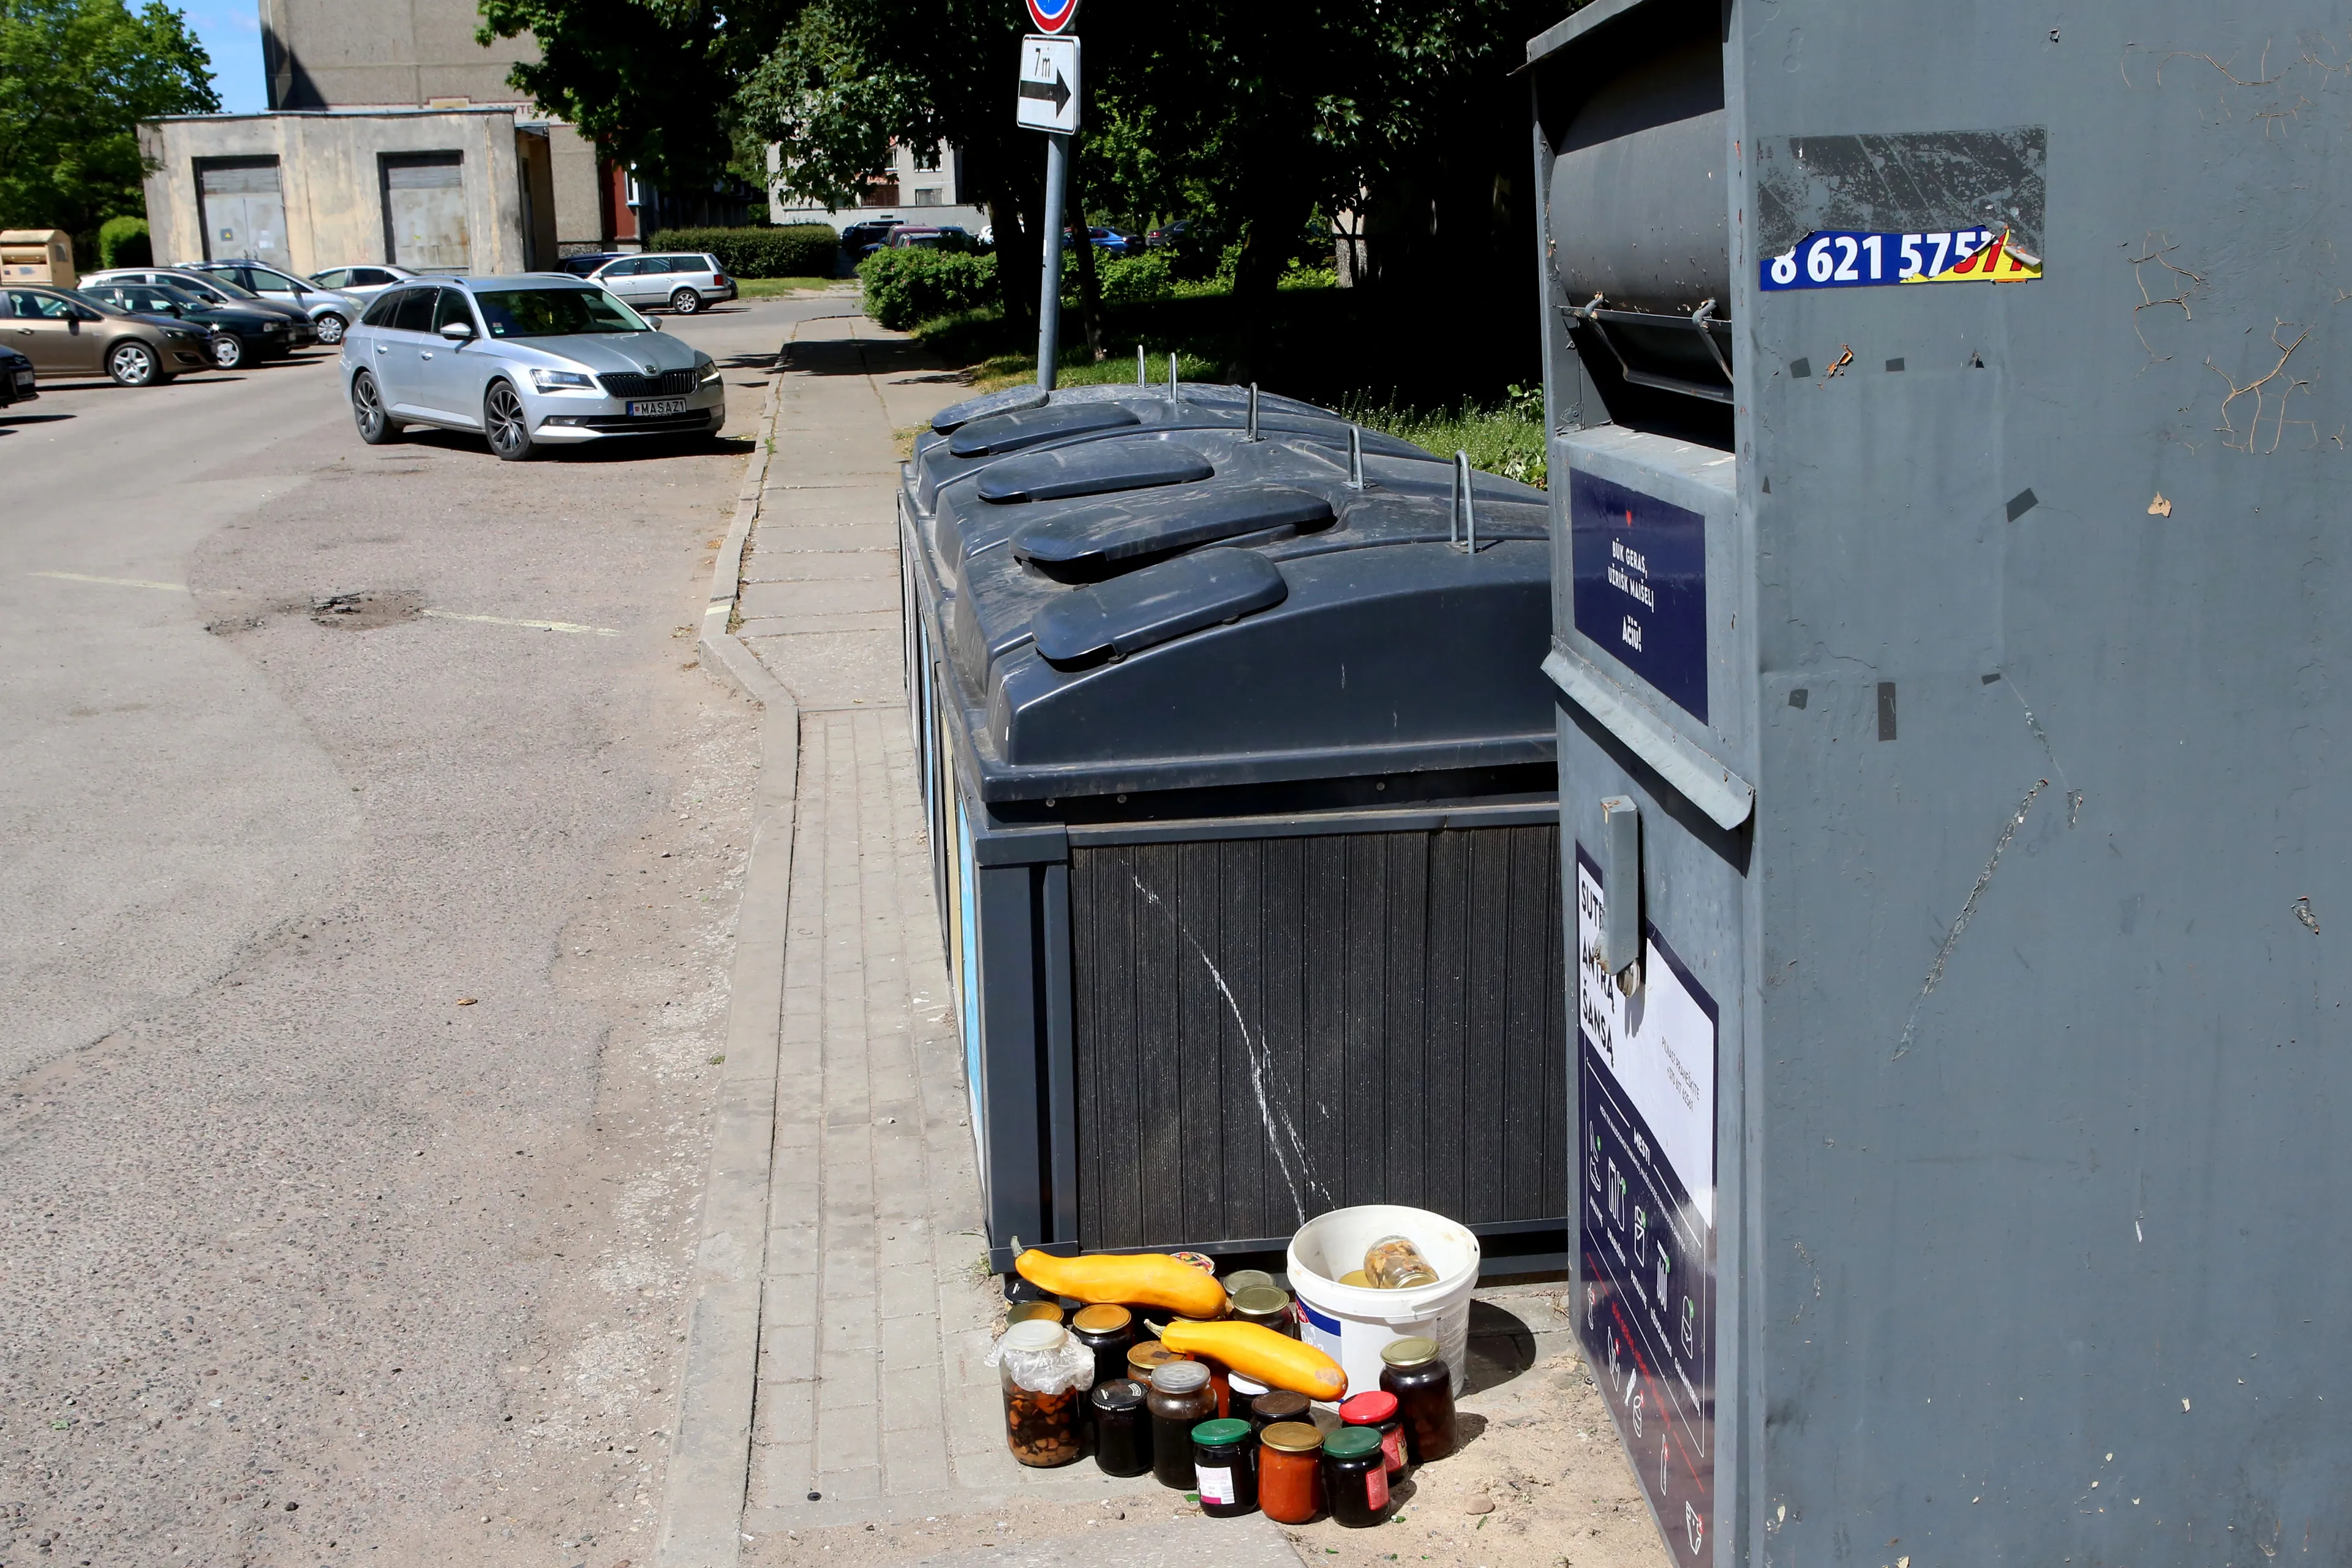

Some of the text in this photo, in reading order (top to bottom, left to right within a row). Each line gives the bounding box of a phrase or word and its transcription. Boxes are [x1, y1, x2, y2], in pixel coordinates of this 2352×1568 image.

[1771, 246, 1797, 285] 8
[1807, 236, 1882, 282] 621
[641, 401, 684, 415] MASAZ1
[1612, 537, 1648, 579] BŪK GERAS,
[1608, 562, 1654, 613] UŽRIŠK MAIŠELĮ
[1582, 976, 1615, 1069] ŠANSĄ
[1662, 1036, 1700, 1101] PILNAS? PRANEŠKITE
[1667, 1067, 1676, 1085] +370
[1634, 1126, 1650, 1166] MESTI
[1650, 1307, 1672, 1358] UŽUOLAIDAS
[1674, 1357, 1701, 1417] GALANTERIJĄ
